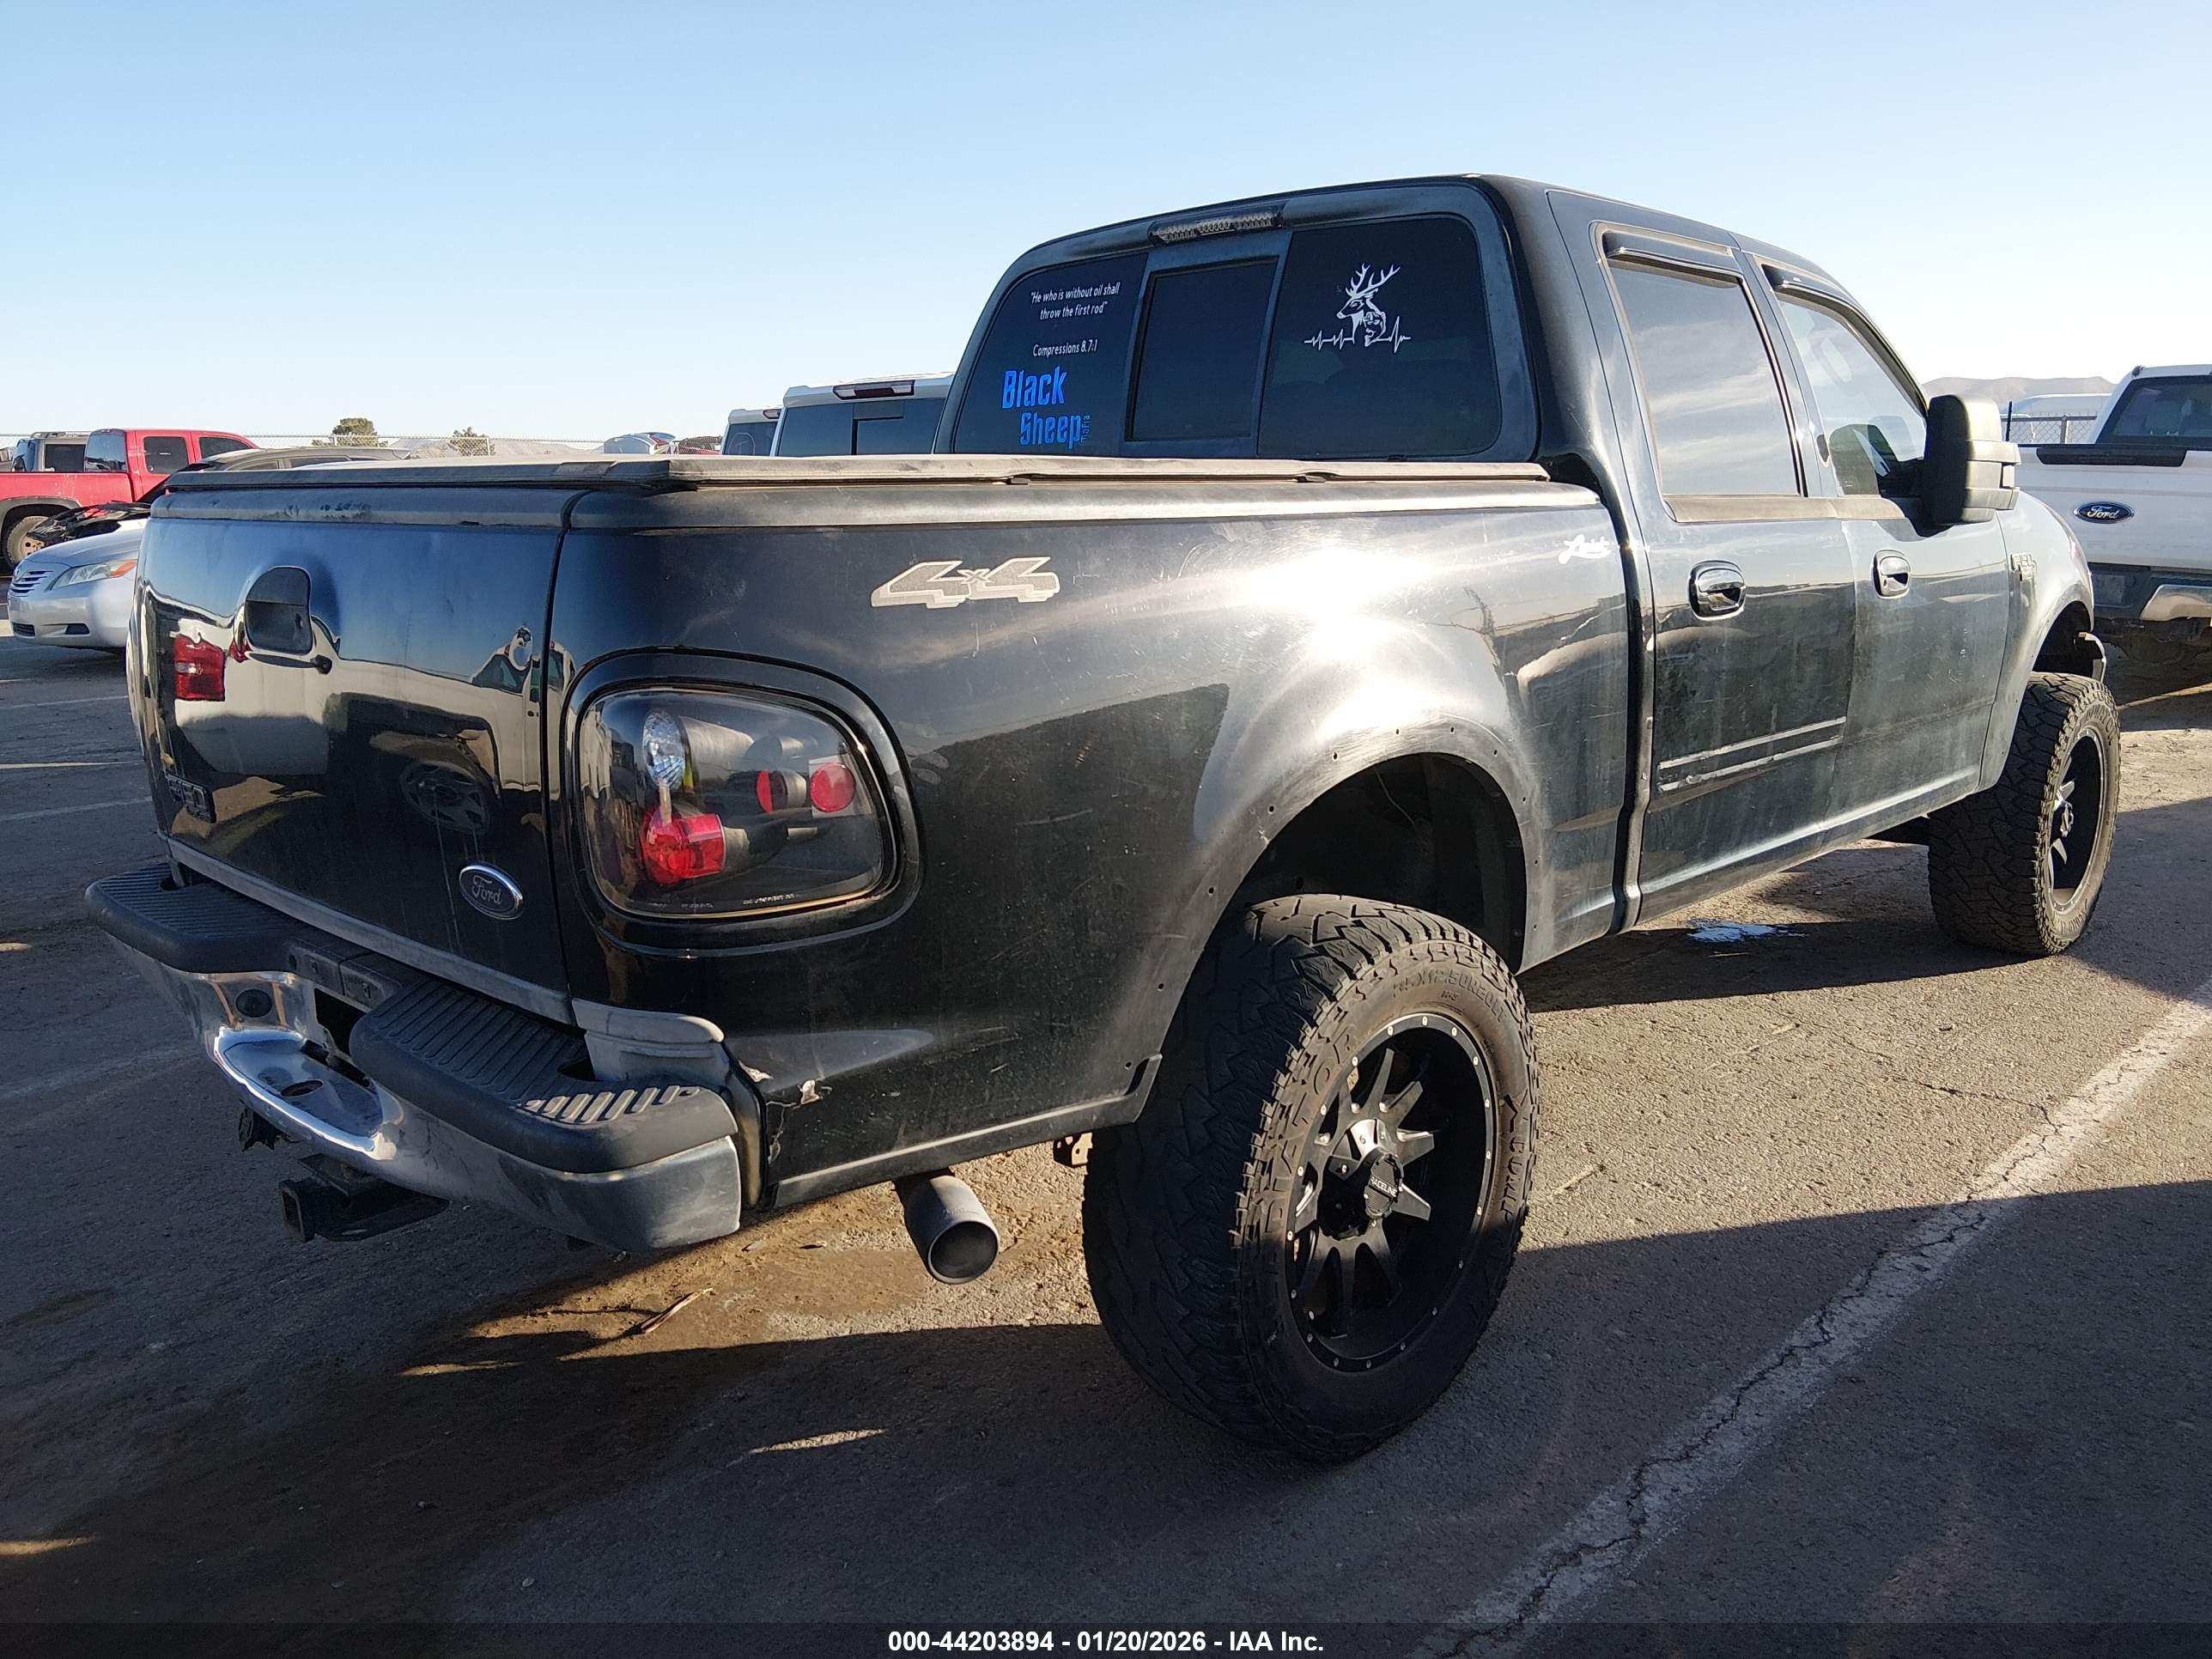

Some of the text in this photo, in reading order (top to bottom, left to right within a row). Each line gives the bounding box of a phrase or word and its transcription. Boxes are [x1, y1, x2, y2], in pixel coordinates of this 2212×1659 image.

[1042, 289, 1057, 301] who
[1057, 289, 1064, 301] is
[1066, 286, 1093, 300] without
[1093, 284, 1103, 296] oil
[1103, 282, 1121, 295] shall
[1040, 307, 1061, 320] throw
[1062, 305, 1073, 318] the
[1074, 303, 1090, 317] first
[1032, 342, 1079, 358] Compressions
[1002, 366, 1067, 409] Black
[1019, 411, 1081, 450] Sheep
